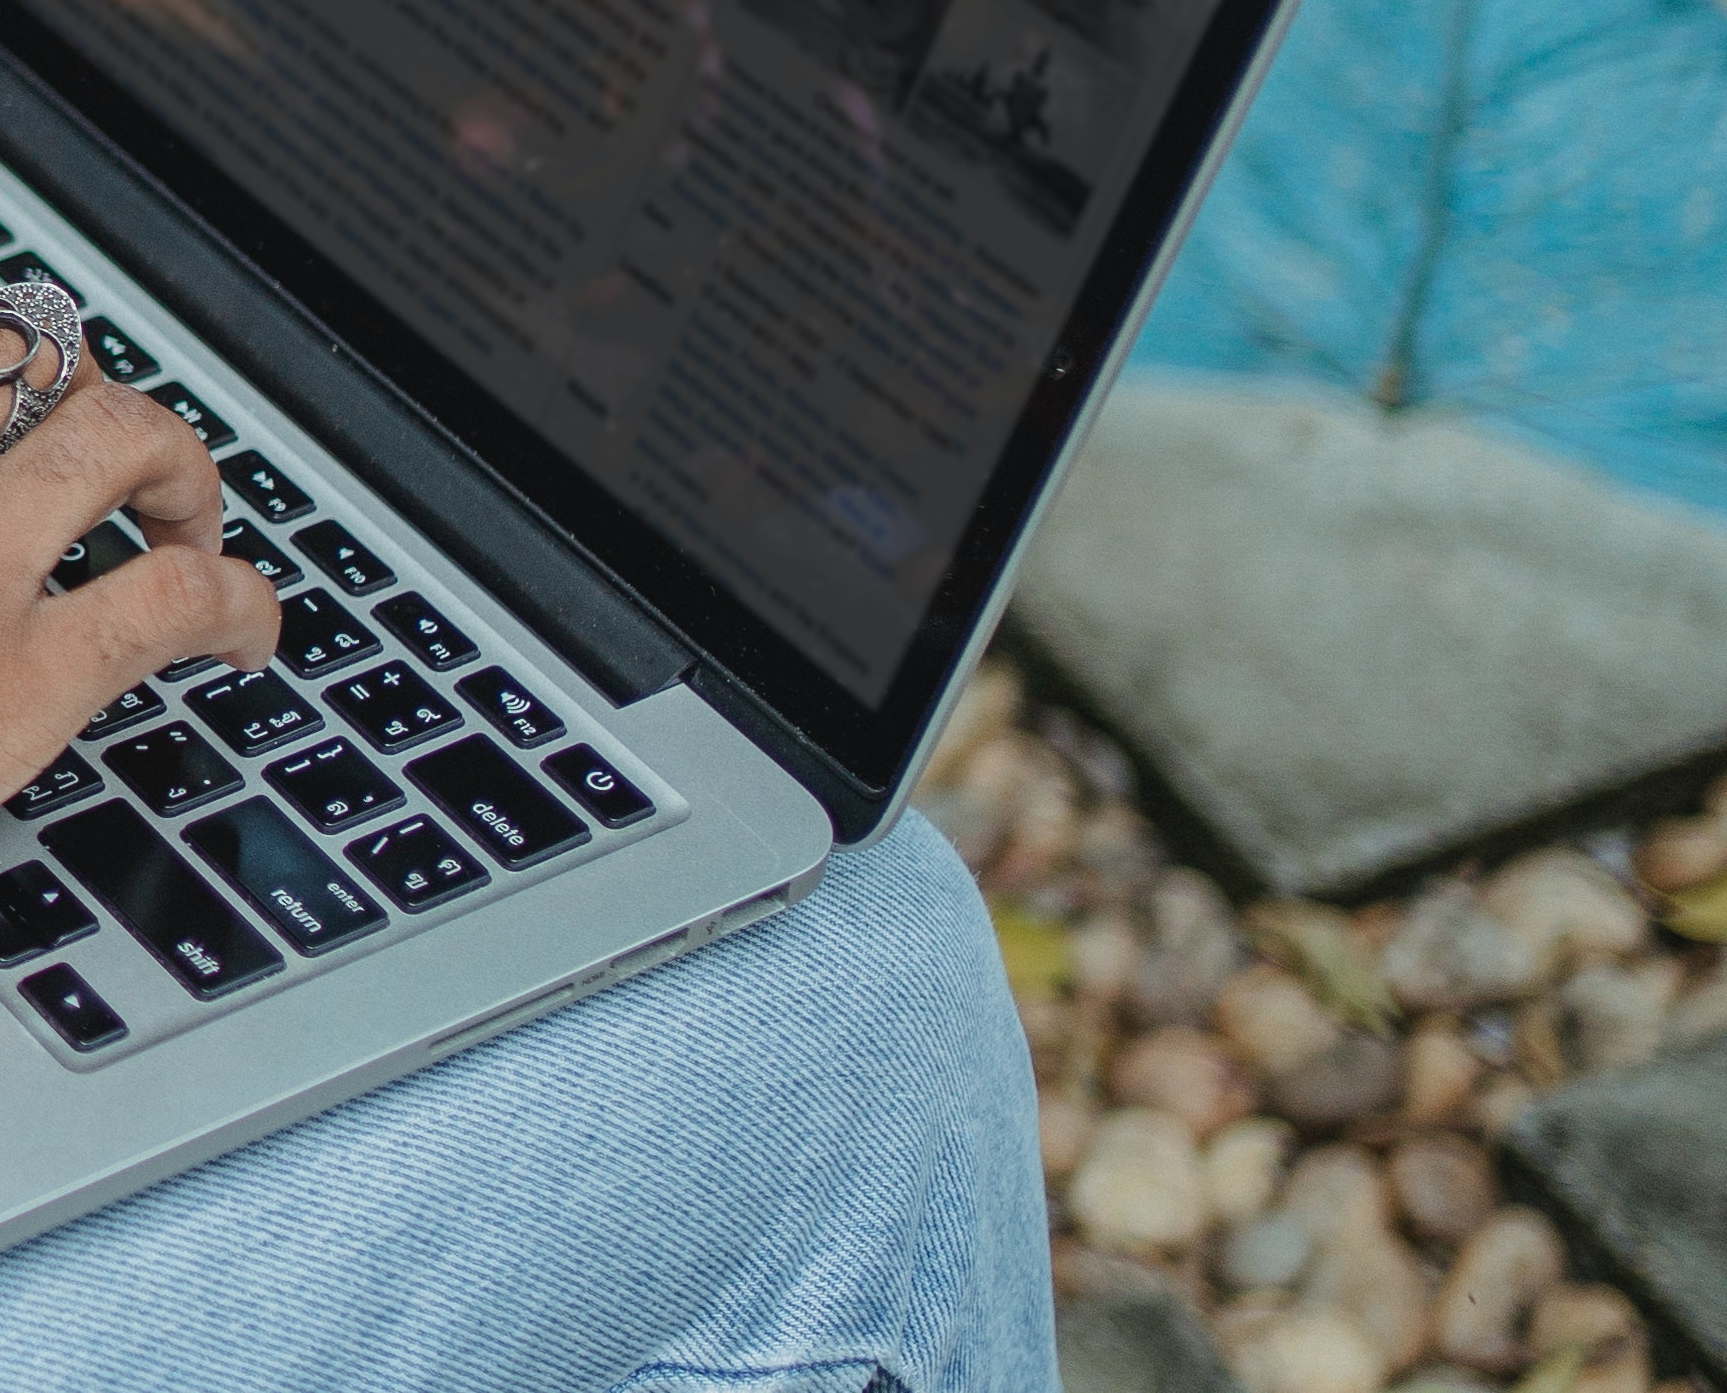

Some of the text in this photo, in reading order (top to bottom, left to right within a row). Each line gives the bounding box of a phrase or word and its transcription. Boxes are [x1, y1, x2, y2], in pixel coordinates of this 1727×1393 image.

[343, 565, 366, 584] F10
[428, 642, 451, 659] F11
[382, 670, 401, 686] +
[205, 684, 232, 699] [
[512, 717, 537, 736] F12
[315, 743, 343, 760] }
[283, 758, 311, 773] ]
[471, 802, 525, 846] delete
[326, 881, 365, 912] enter
[270, 888, 322, 933] return
[176, 941, 220, 975] shift
